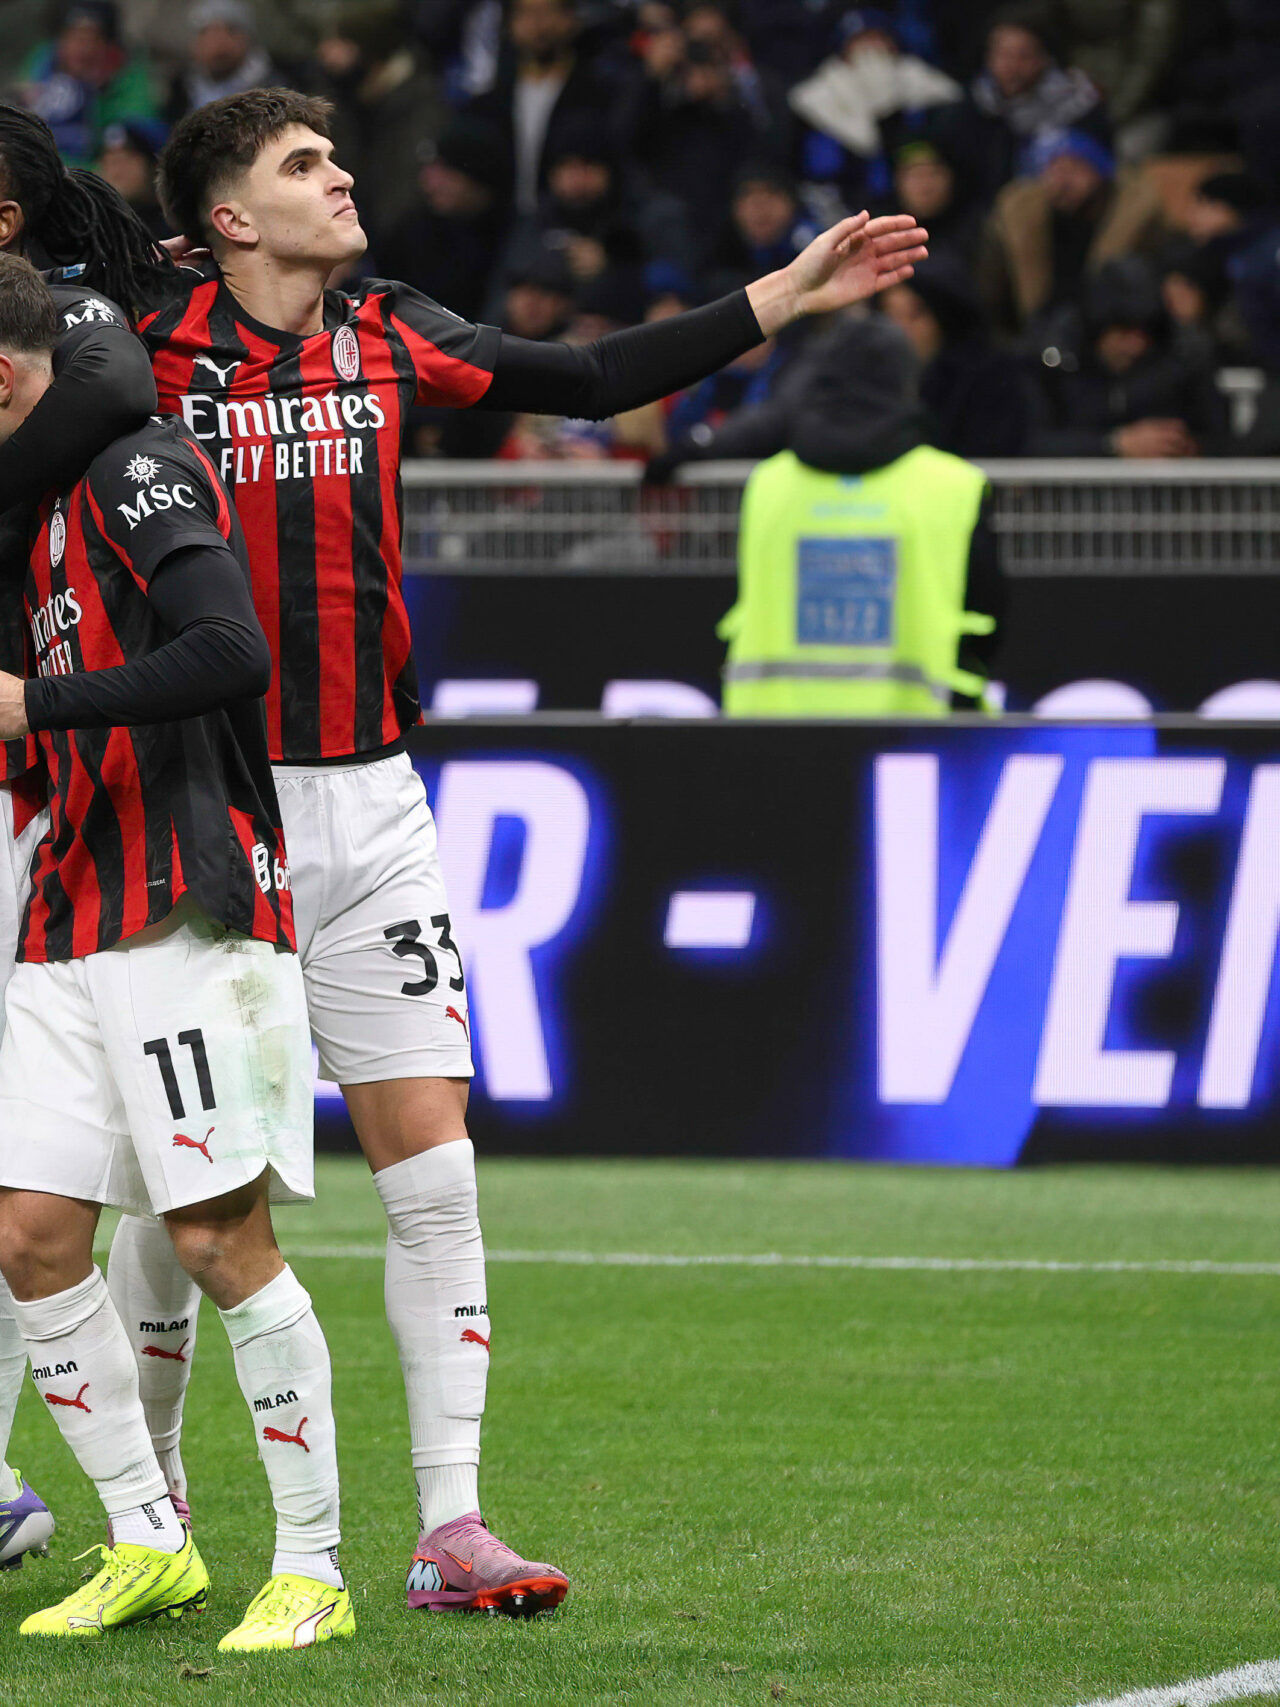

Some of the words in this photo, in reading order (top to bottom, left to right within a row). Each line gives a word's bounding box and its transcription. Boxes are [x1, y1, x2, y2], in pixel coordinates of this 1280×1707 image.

[179, 390, 386, 440] Emirates
[221, 445, 265, 484] FLY
[275, 437, 364, 481] BETTER
[117, 483, 197, 531] MSC
[30, 587, 82, 655] irates
[383, 912, 464, 997] 33
[143, 1028, 216, 1121] 11
[254, 1390, 299, 1412] MILAN
